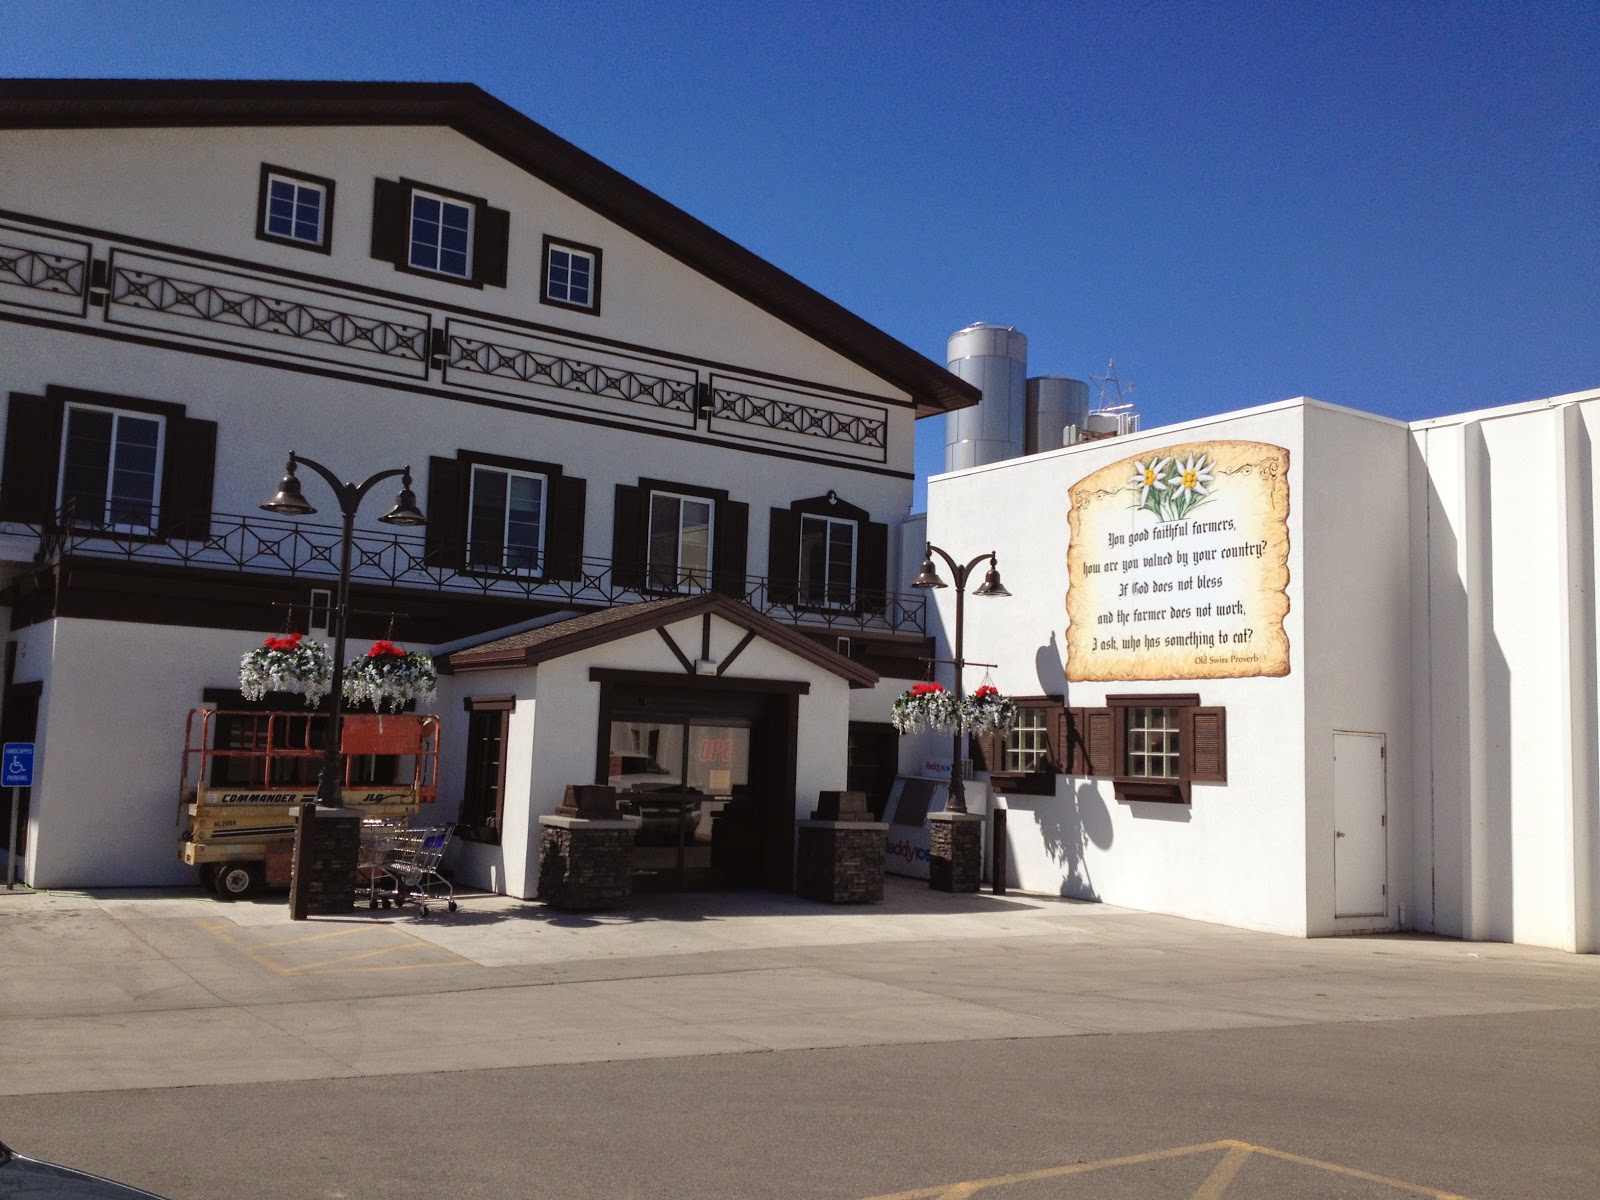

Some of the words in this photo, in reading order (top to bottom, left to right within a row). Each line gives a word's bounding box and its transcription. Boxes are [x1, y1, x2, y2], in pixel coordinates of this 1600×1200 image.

[1129, 529, 1149, 546] good
[1153, 522, 1188, 541] faithful
[1193, 519, 1236, 535] farmers,
[1083, 562, 1100, 578] how
[1104, 562, 1118, 573] are
[1122, 559, 1138, 574] you
[1143, 552, 1173, 567] valued
[1177, 551, 1188, 567] by
[1193, 549, 1217, 565] your
[1221, 530, 1267, 559] country?
[1132, 583, 1149, 596] God
[1153, 579, 1173, 593] does
[1178, 577, 1193, 590] not
[1197, 575, 1222, 589] bless
[1098, 612, 1113, 624] and
[1117, 610, 1130, 626] the
[1133, 607, 1166, 622] farmer
[1170, 606, 1191, 619] does
[1196, 604, 1211, 617] not
[1217, 601, 1246, 616] work,
[1101, 637, 1119, 651] ask,
[1122, 637, 1141, 652] who
[1144, 635, 1161, 651] has
[1165, 631, 1215, 649] something
[1219, 630, 1228, 644] to
[1233, 629, 1253, 643] eat?
[1195, 657, 1206, 665] Old
[1209, 656, 1228, 664] Swiss
[1230, 655, 1258, 663] Proverb
[222, 794, 296, 802] COMMANDER
[363, 794, 384, 802] JLG
